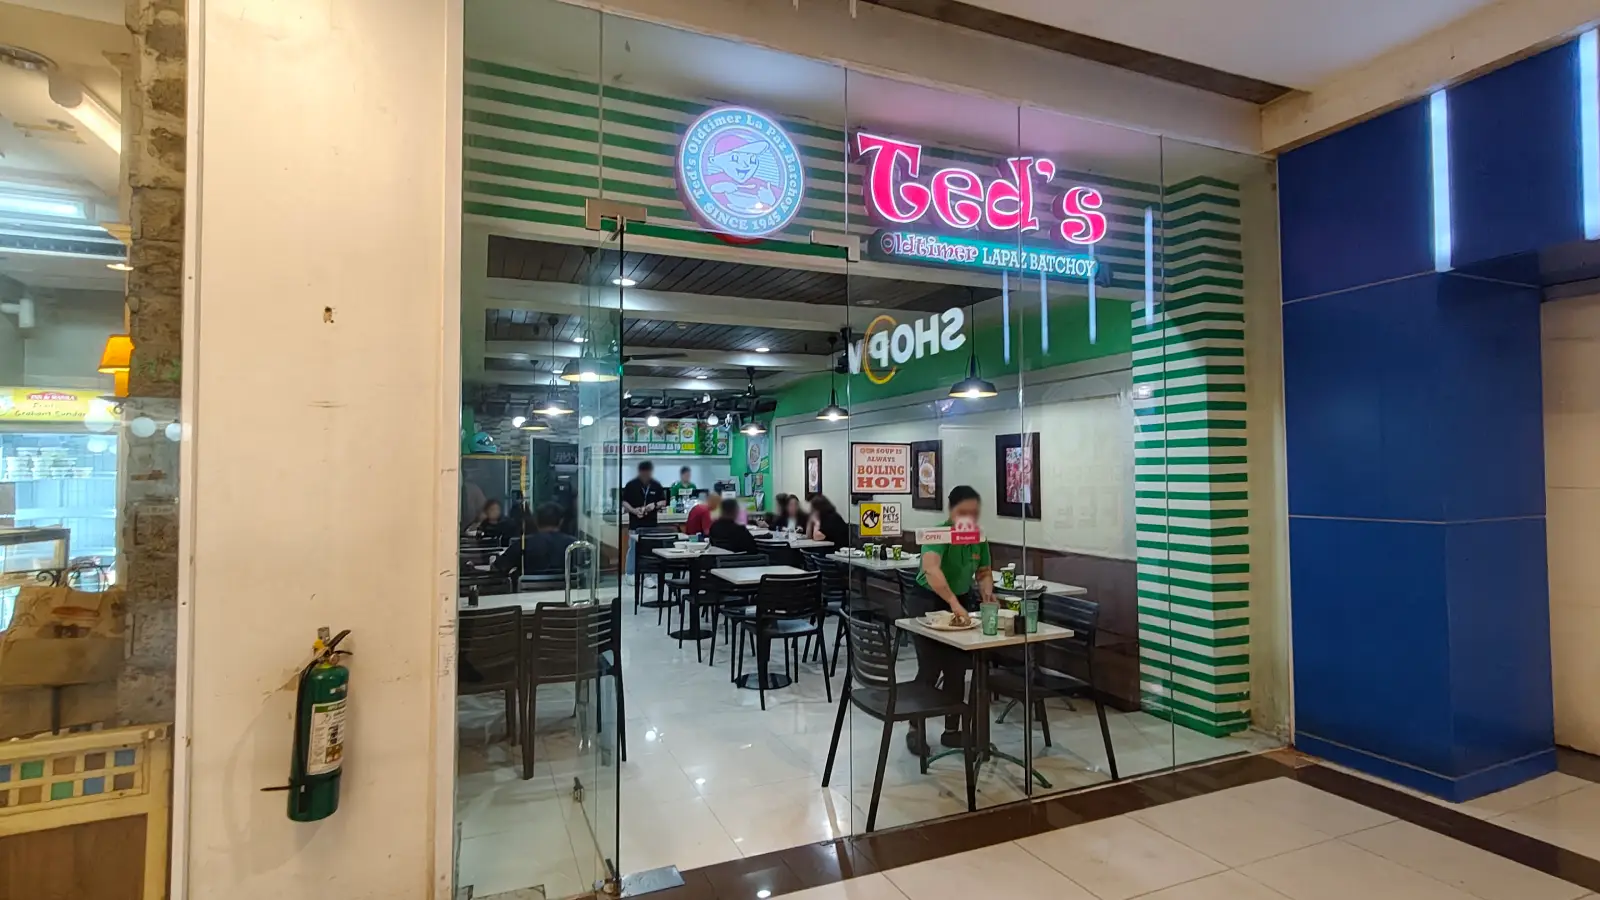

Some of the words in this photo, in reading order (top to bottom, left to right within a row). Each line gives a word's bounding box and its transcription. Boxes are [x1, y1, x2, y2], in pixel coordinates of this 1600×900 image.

[688, 114, 742, 154] Oldtimer
[746, 114, 763, 129] La
[766, 126, 787, 151] Paz
[687, 158, 705, 199] Ted's
[780, 153, 798, 213] Batchoy
[857, 132, 1107, 245] Ted's
[703, 202, 749, 230] SINCE
[753, 213, 781, 230] 1945
[881, 232, 979, 262] Oldtimer
[982, 248, 1028, 270] LAPAZ
[1029, 253, 1096, 277] BATCHOY
[857, 465, 905, 475] BOILING
[857, 477, 905, 488] HOT
[882, 505, 896, 513] NO
[882, 513, 900, 521] PETS
